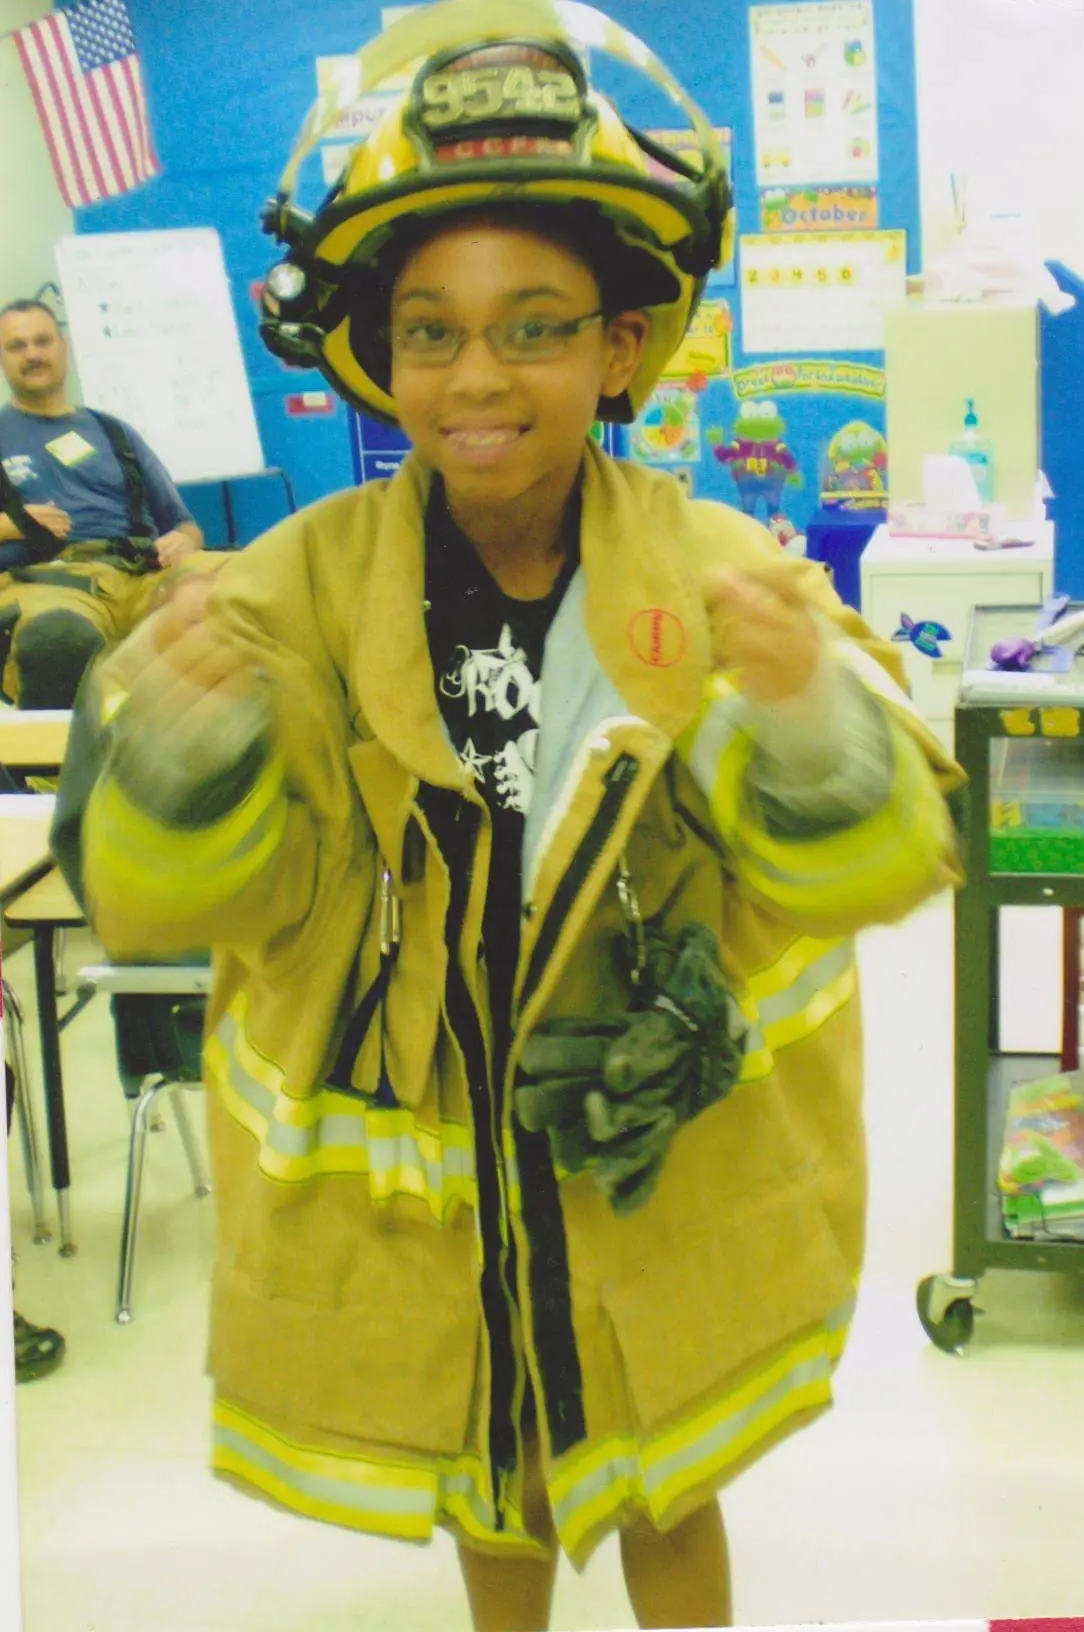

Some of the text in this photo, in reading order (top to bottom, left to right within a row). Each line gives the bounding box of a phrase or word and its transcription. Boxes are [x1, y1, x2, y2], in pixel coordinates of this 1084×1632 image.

[422, 66, 581, 126] 9542
[782, 204, 867, 224] October
[792, 267, 803, 280] 4
